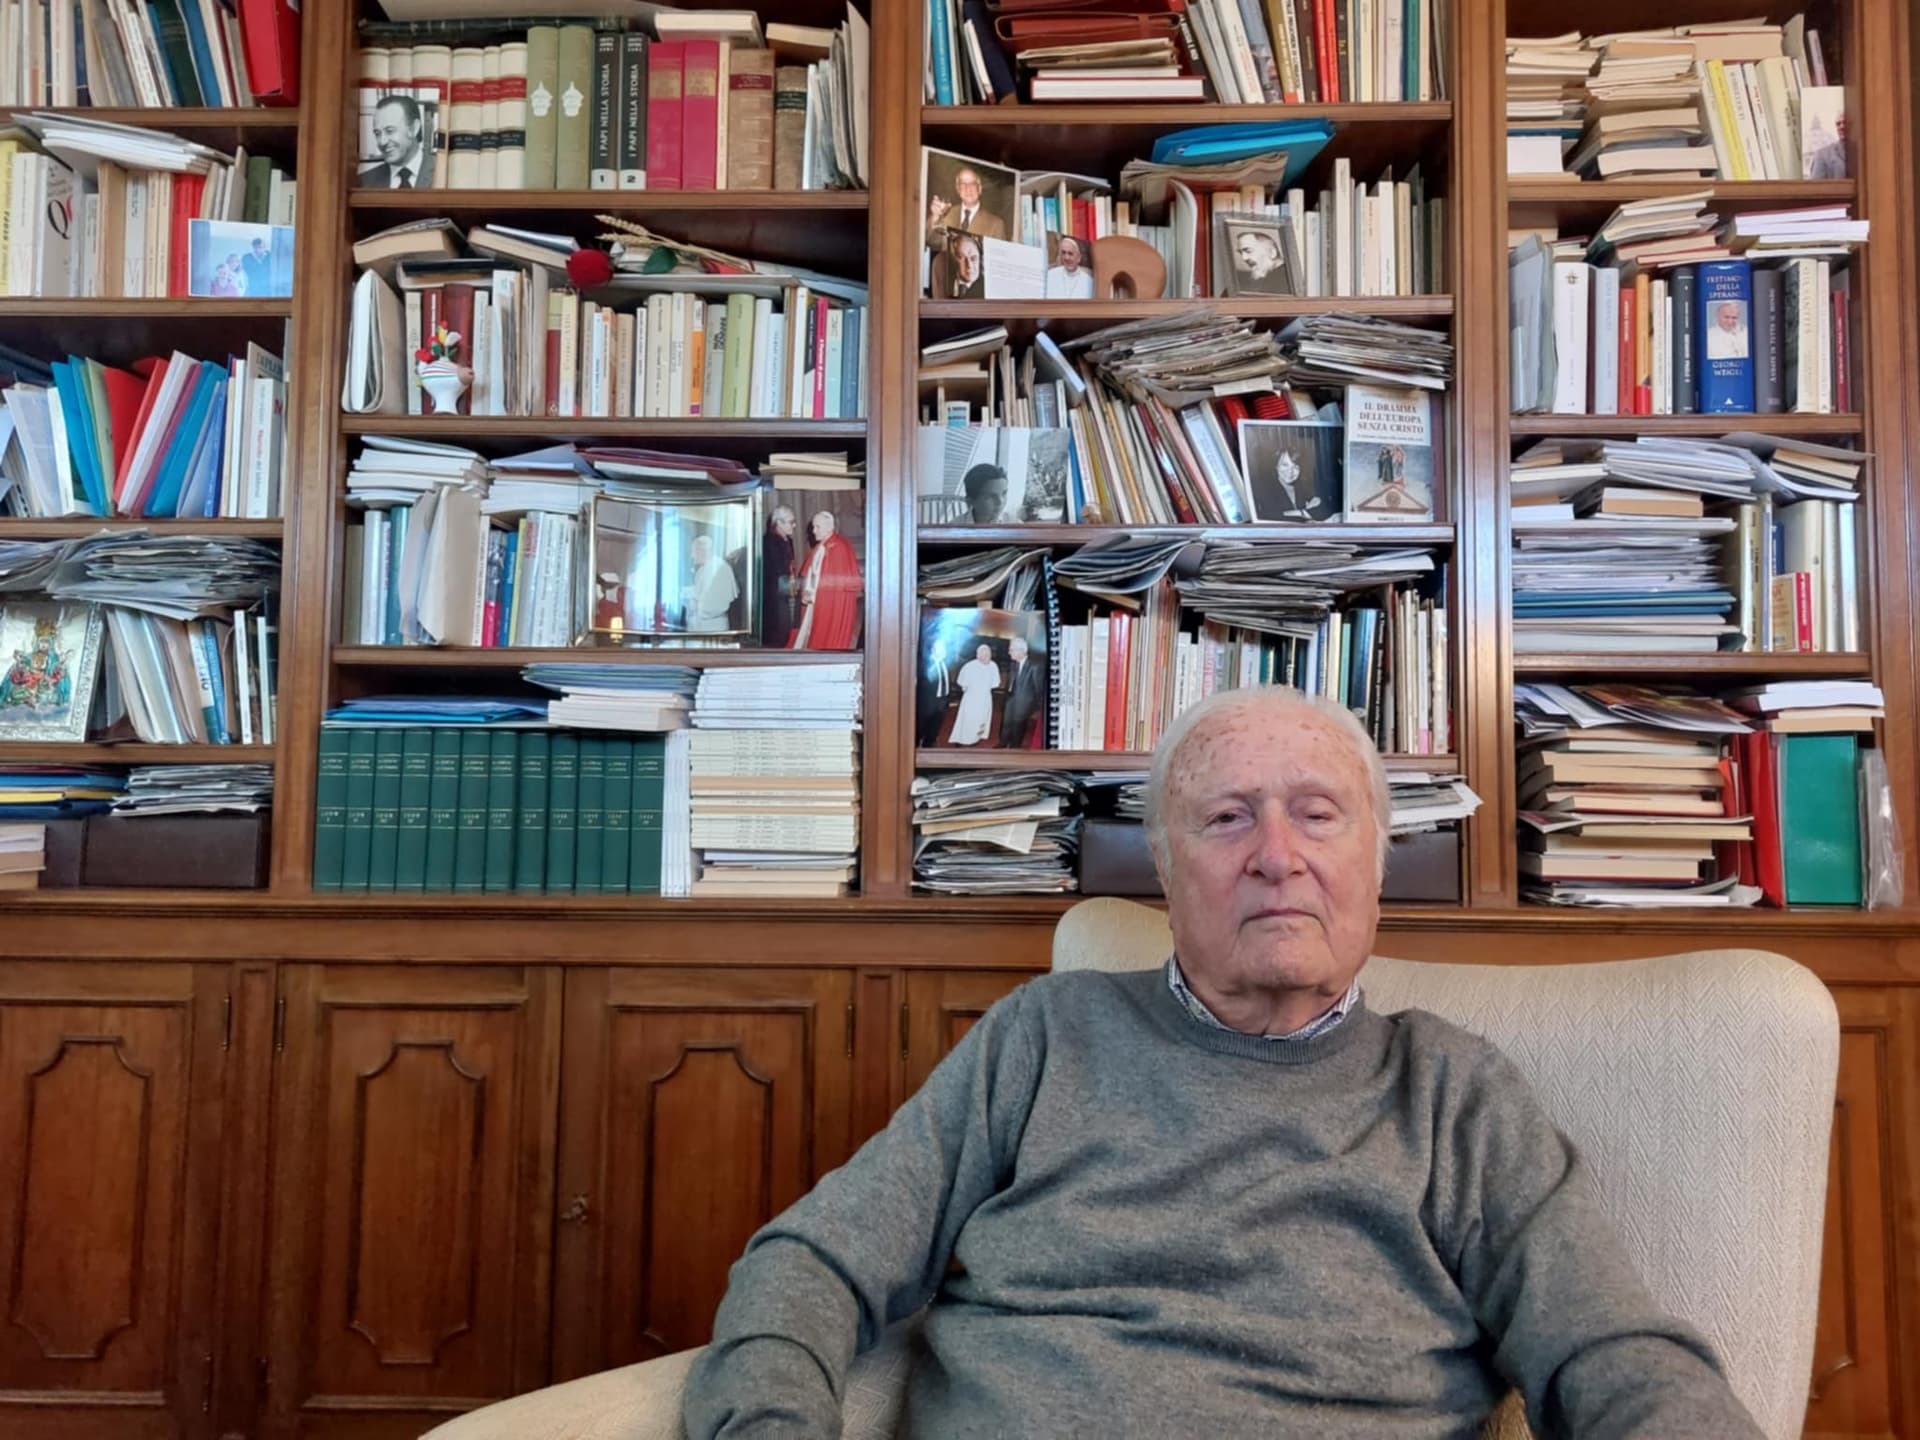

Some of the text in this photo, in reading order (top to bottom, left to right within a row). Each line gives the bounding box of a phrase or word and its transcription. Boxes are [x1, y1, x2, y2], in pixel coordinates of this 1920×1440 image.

[601, 64, 610, 97] STORIA
[629, 64, 639, 97] STORIA
[600, 99, 609, 128] NELLA
[629, 99, 638, 128] NELLA
[600, 129, 609, 151] PAPI
[628, 130, 637, 151] PAPI
[1359, 412, 1422, 424] DELL'EUROPA
[1364, 402, 1417, 413] IL DRAMMA
[1357, 421, 1424, 433] SENZA CRISTO
